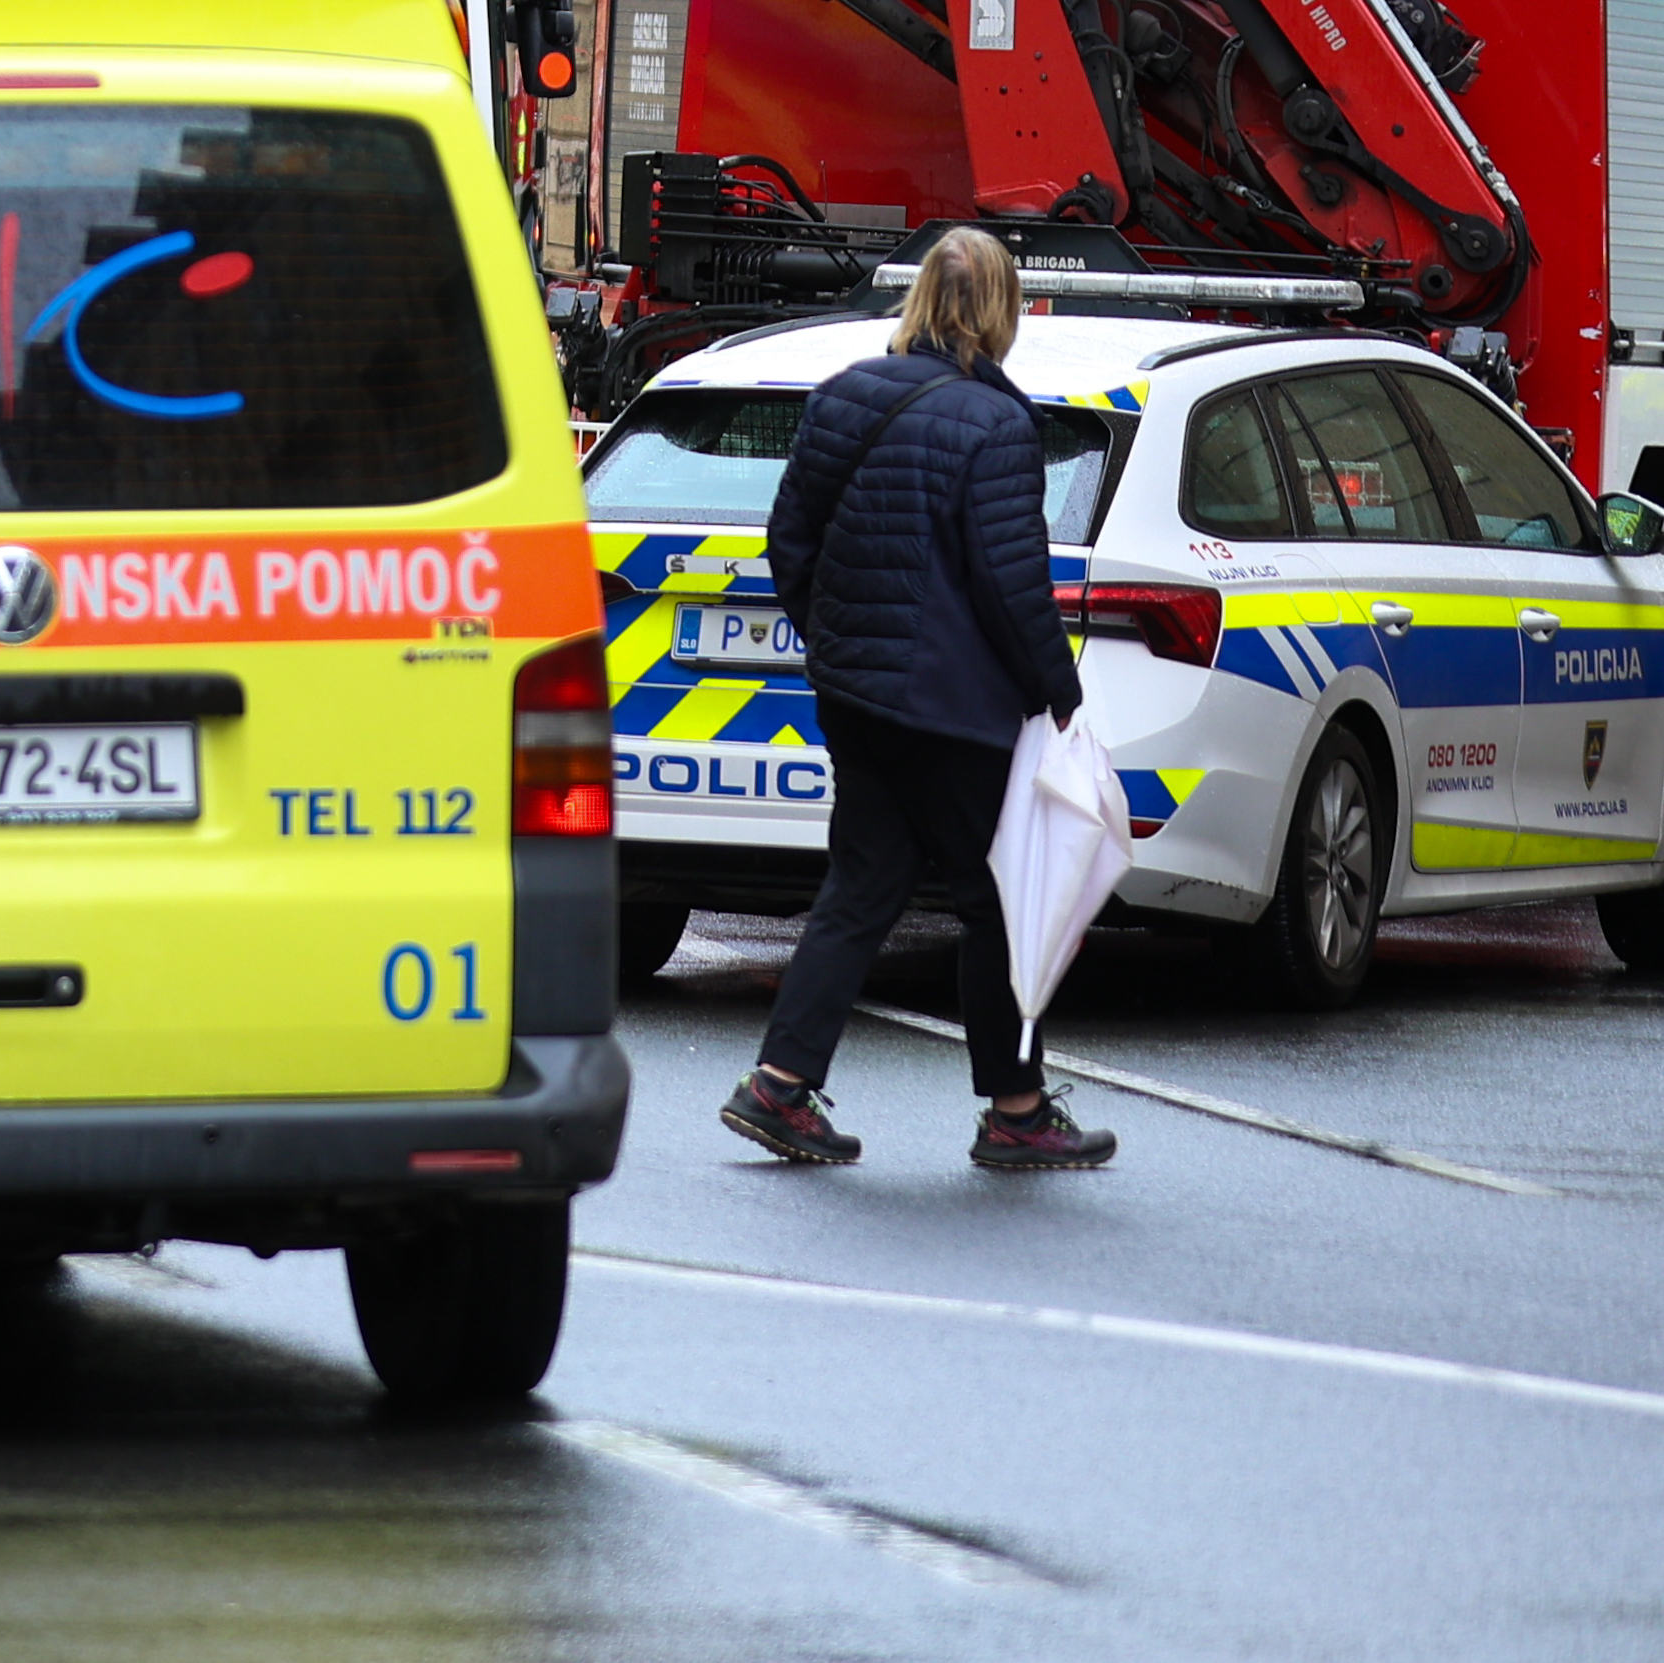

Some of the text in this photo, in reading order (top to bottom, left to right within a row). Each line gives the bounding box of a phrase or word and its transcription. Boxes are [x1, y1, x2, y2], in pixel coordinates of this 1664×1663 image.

[1310, 3, 1347, 52] HIPRO
[1025, 255, 1087, 271] BRIGADA
[1188, 541, 1234, 561] 113
[256, 530, 501, 616] POMOČ
[1207, 564, 1282, 581] NUJNI KLICI
[680, 637, 697, 650] SLO
[721, 614, 744, 651] P
[1554, 647, 1643, 684] POLICIJA
[1427, 743, 1497, 768] 080 1200
[612, 752, 827, 800] POLIC
[1425, 775, 1495, 794] ANONIMNI KLICI
[268, 788, 476, 836] TEL 112
[1554, 798, 1628, 819] WWW.POLICIJA.SI
[382, 941, 487, 1021] 01
